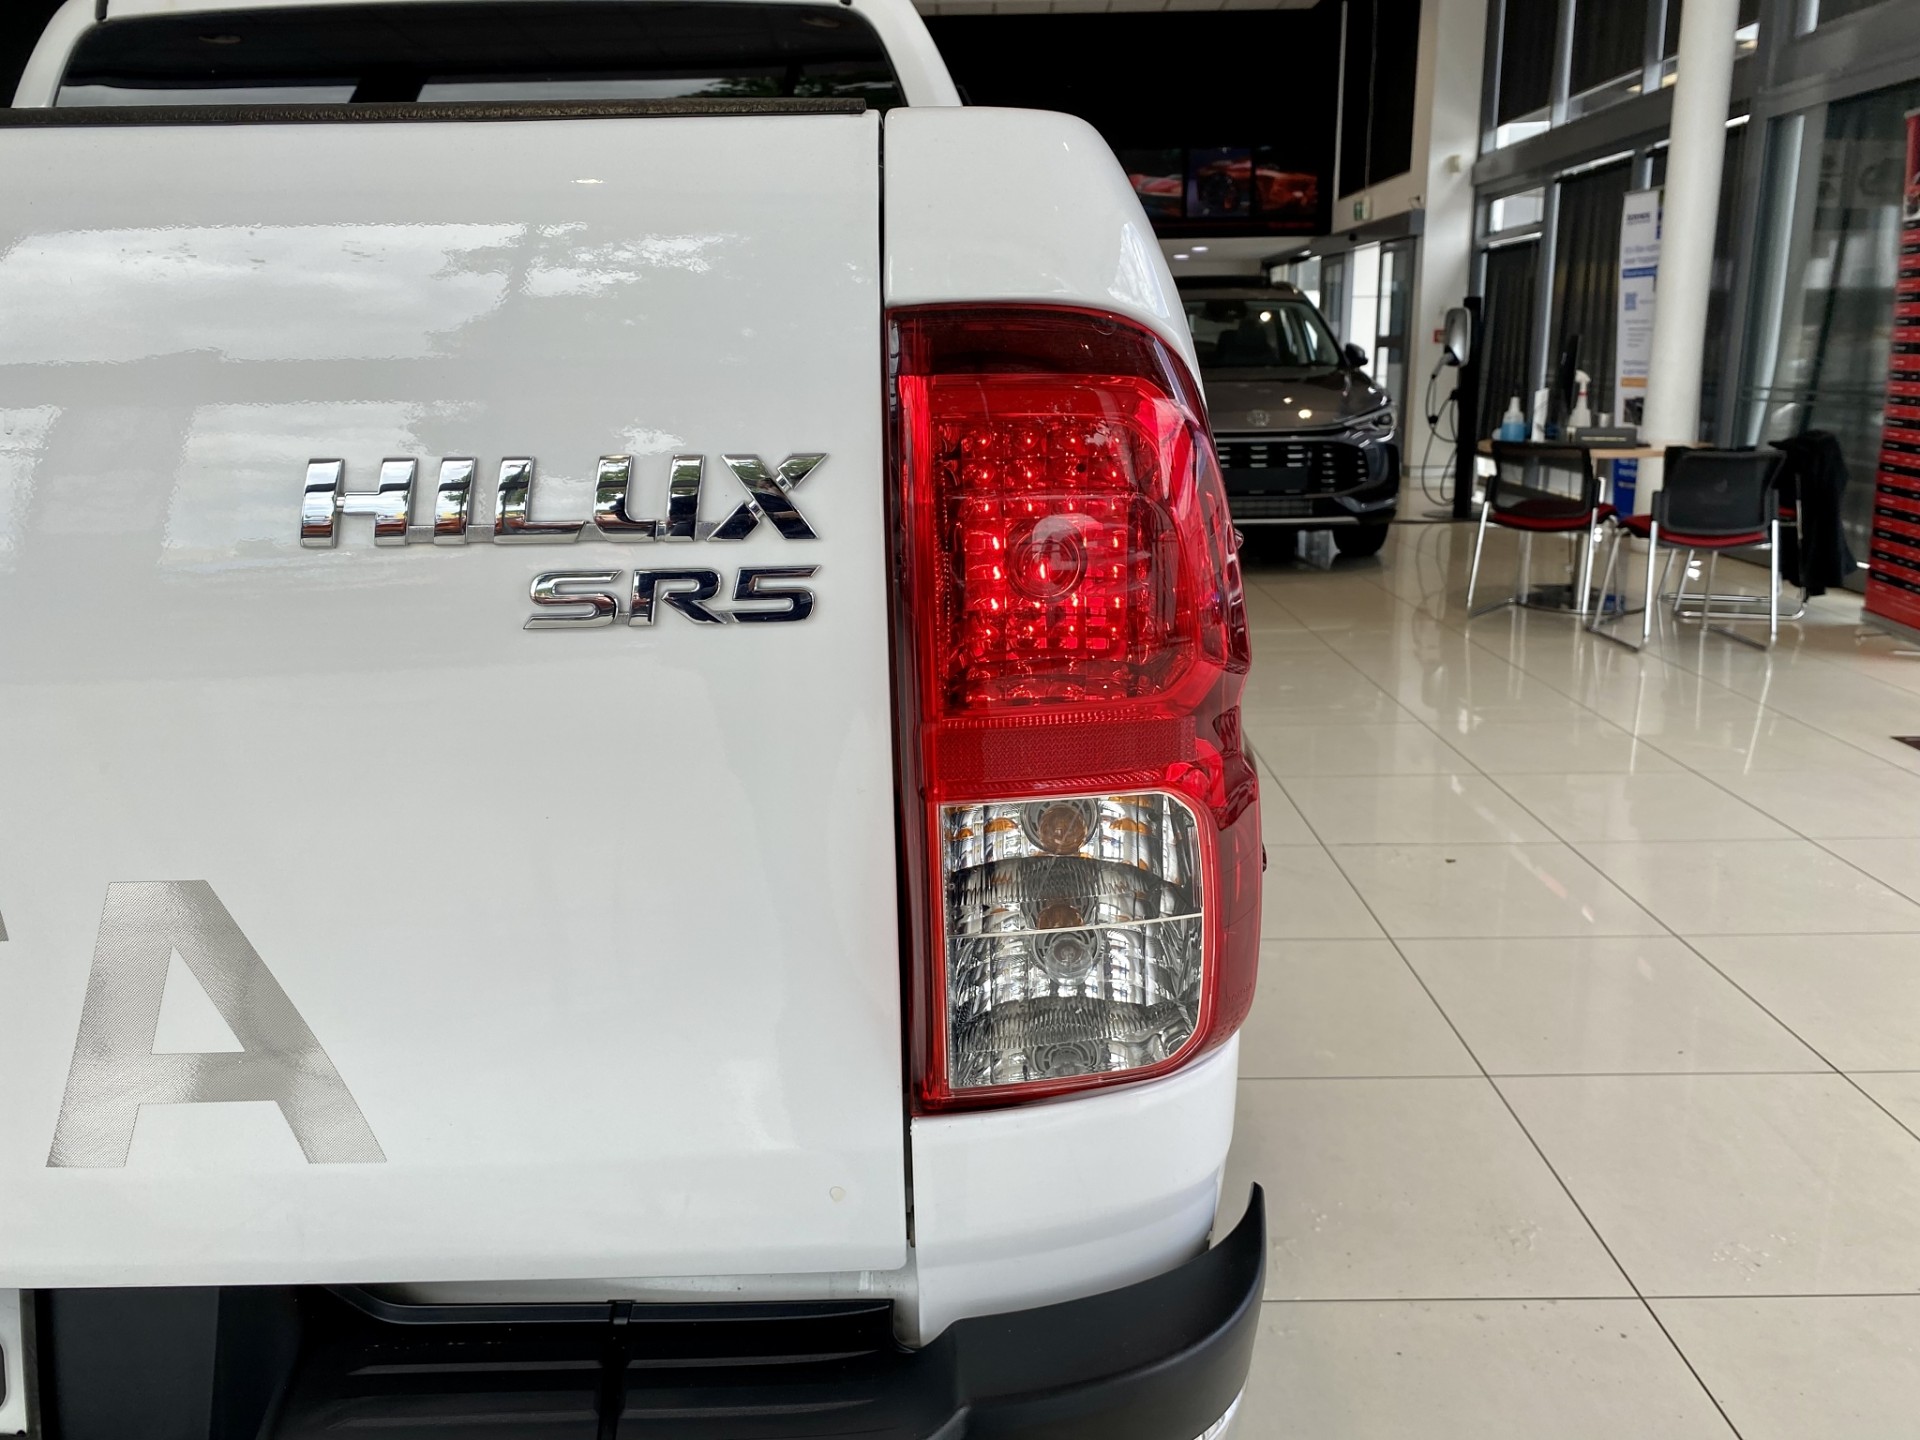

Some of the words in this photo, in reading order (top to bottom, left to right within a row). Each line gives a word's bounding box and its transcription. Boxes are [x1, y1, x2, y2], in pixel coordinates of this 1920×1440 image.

[300, 453, 828, 548] HILUX
[523, 564, 822, 630] SR5
[0, 880, 388, 1168] A
